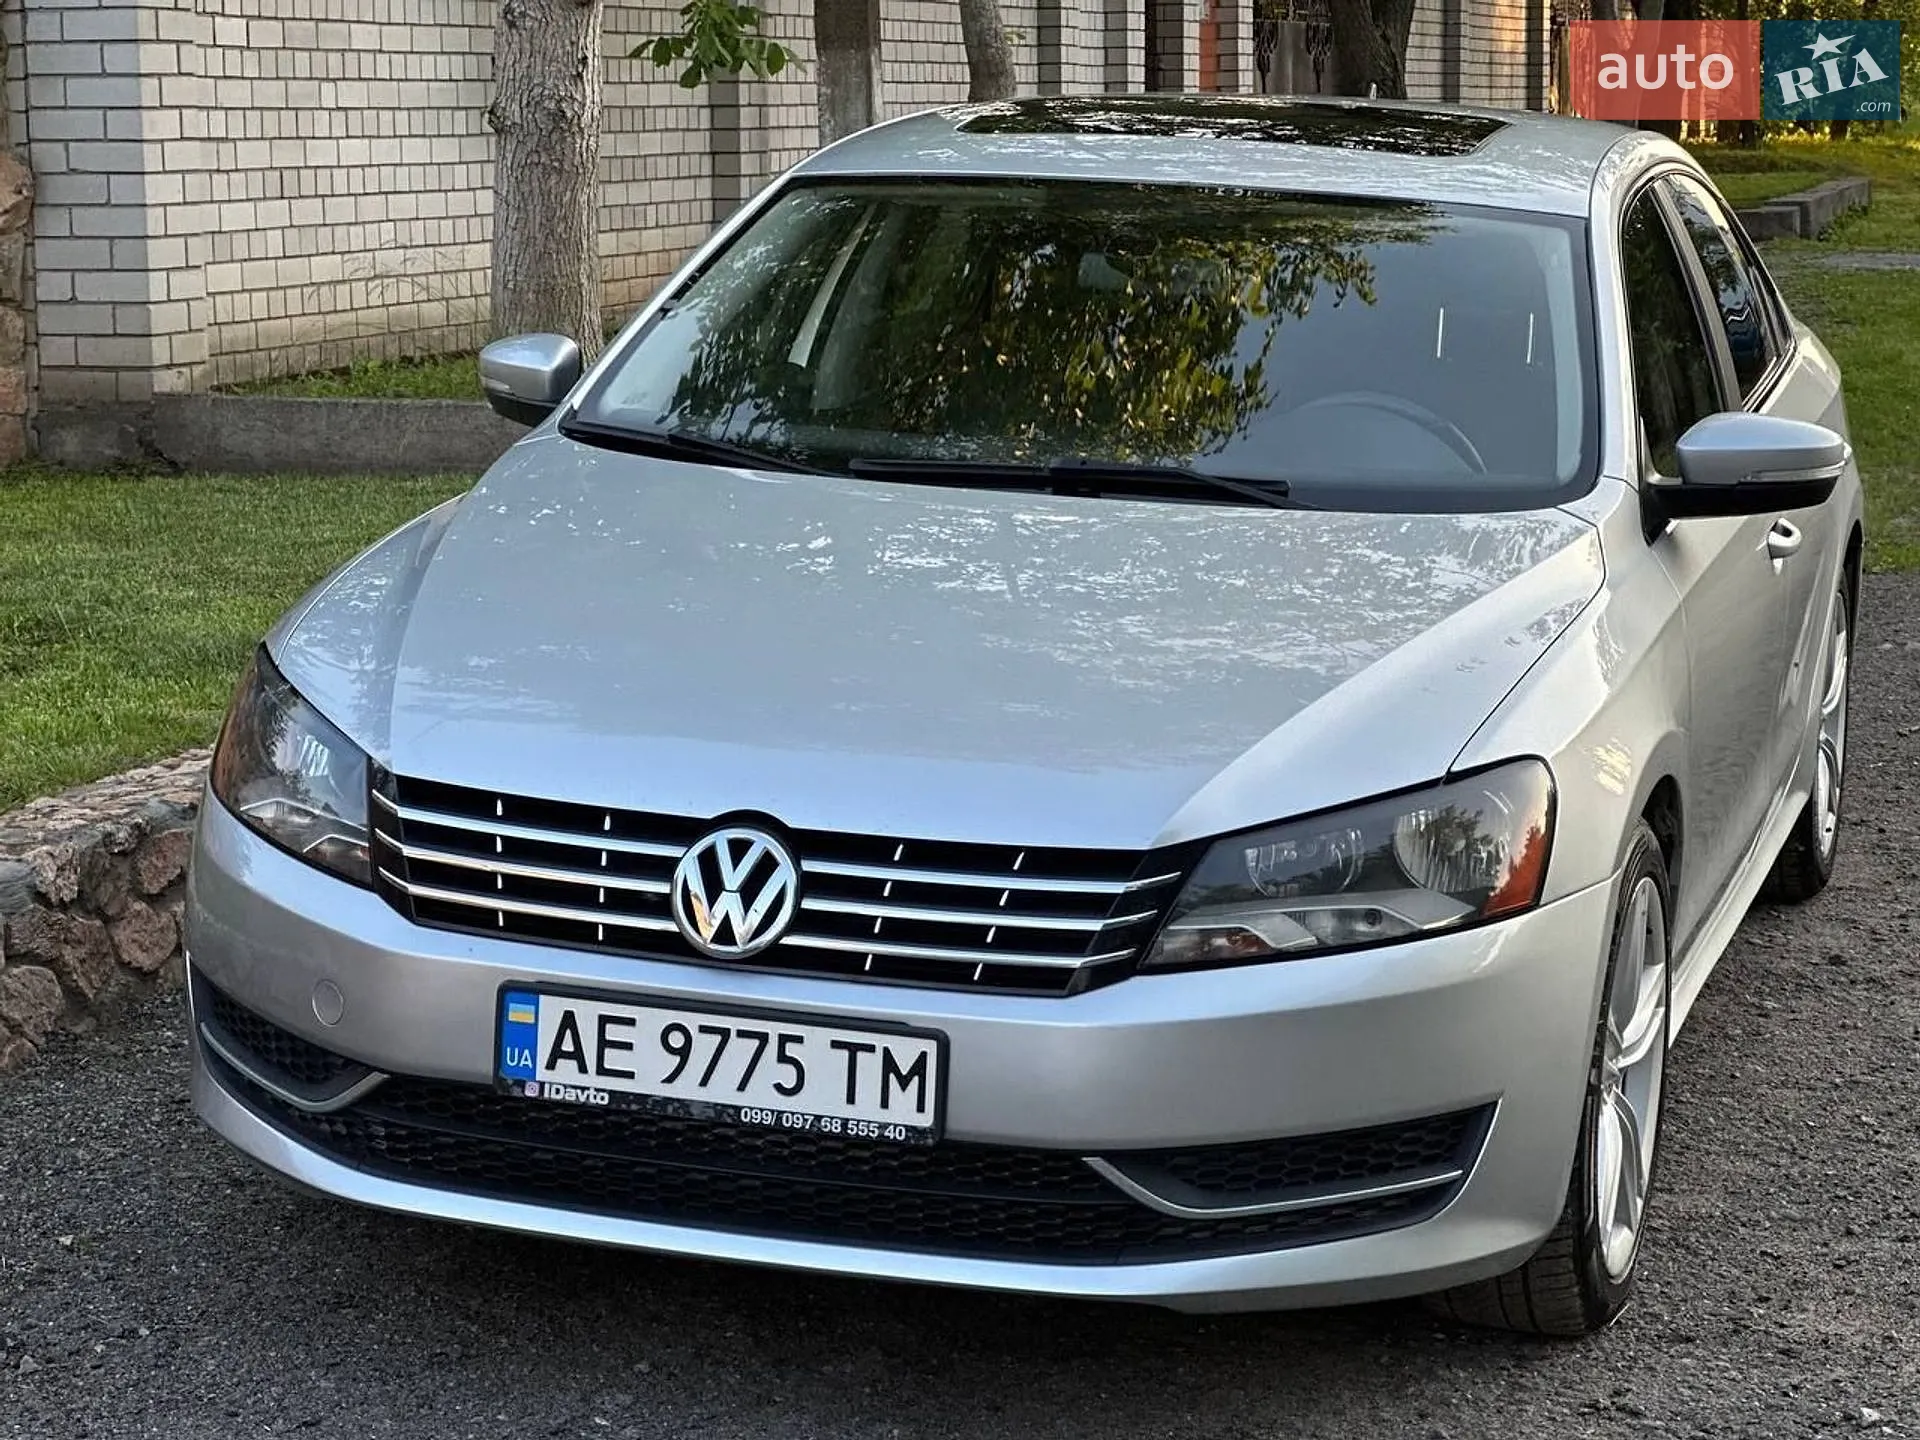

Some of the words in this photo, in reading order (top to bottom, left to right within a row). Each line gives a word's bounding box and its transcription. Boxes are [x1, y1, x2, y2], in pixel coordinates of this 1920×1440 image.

[506, 1047, 533, 1070] UA
[545, 1009, 636, 1080] AE
[660, 1022, 805, 1096] 9775
[830, 1039, 928, 1113] TM
[740, 1107, 778, 1126] 099/
[782, 1112, 814, 1130] 097
[847, 1120, 879, 1138] 555
[884, 1124, 906, 1141] 40
